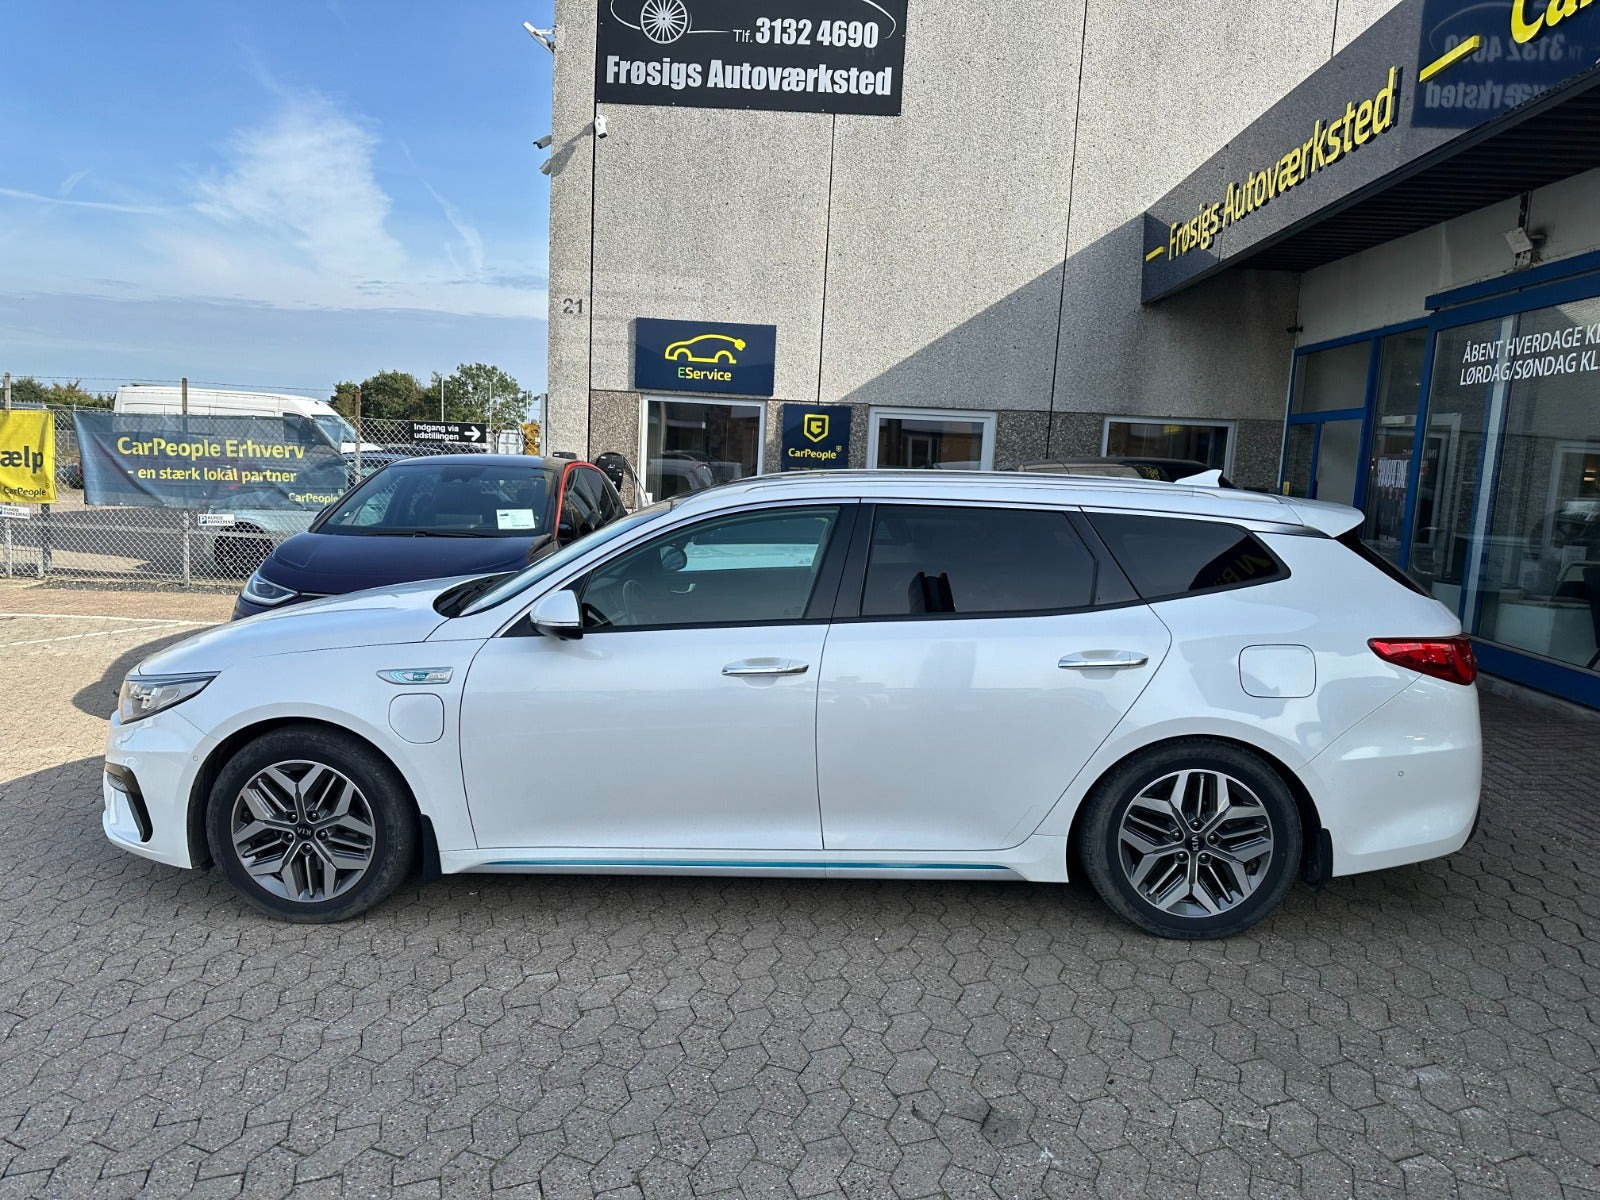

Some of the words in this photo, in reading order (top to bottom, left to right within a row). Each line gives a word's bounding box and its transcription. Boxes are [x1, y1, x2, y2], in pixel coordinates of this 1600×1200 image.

[732, 29, 753, 43] Tlf.
[755, 17, 810, 45] 3132
[816, 19, 879, 48] 4690
[605, 55, 702, 90] Frøsigs
[706, 59, 893, 96] Autoværksted
[1168, 203, 1220, 261] Frøsigs
[1221, 65, 1396, 229] Autoværksted
[563, 297, 583, 313] 21
[1463, 339, 1503, 363] ÅBENT
[1505, 326, 1583, 357] HVERDAGE
[677, 366, 732, 382] EService
[1460, 352, 1577, 386] LØRDAG/SØNDAG
[413, 423, 446, 433] Indgang
[448, 424, 459, 432] via
[413, 432, 459, 441] udstillingen
[117, 436, 221, 461] CarPeople
[225, 439, 305, 459] Erhverv
[787, 447, 837, 461] CarPeople
[137, 469, 156, 479] en
[159, 467, 200, 480] stærk
[204, 468, 238, 481] lokal
[242, 468, 297, 483] partner
[3, 486, 47, 498] CarPeople
